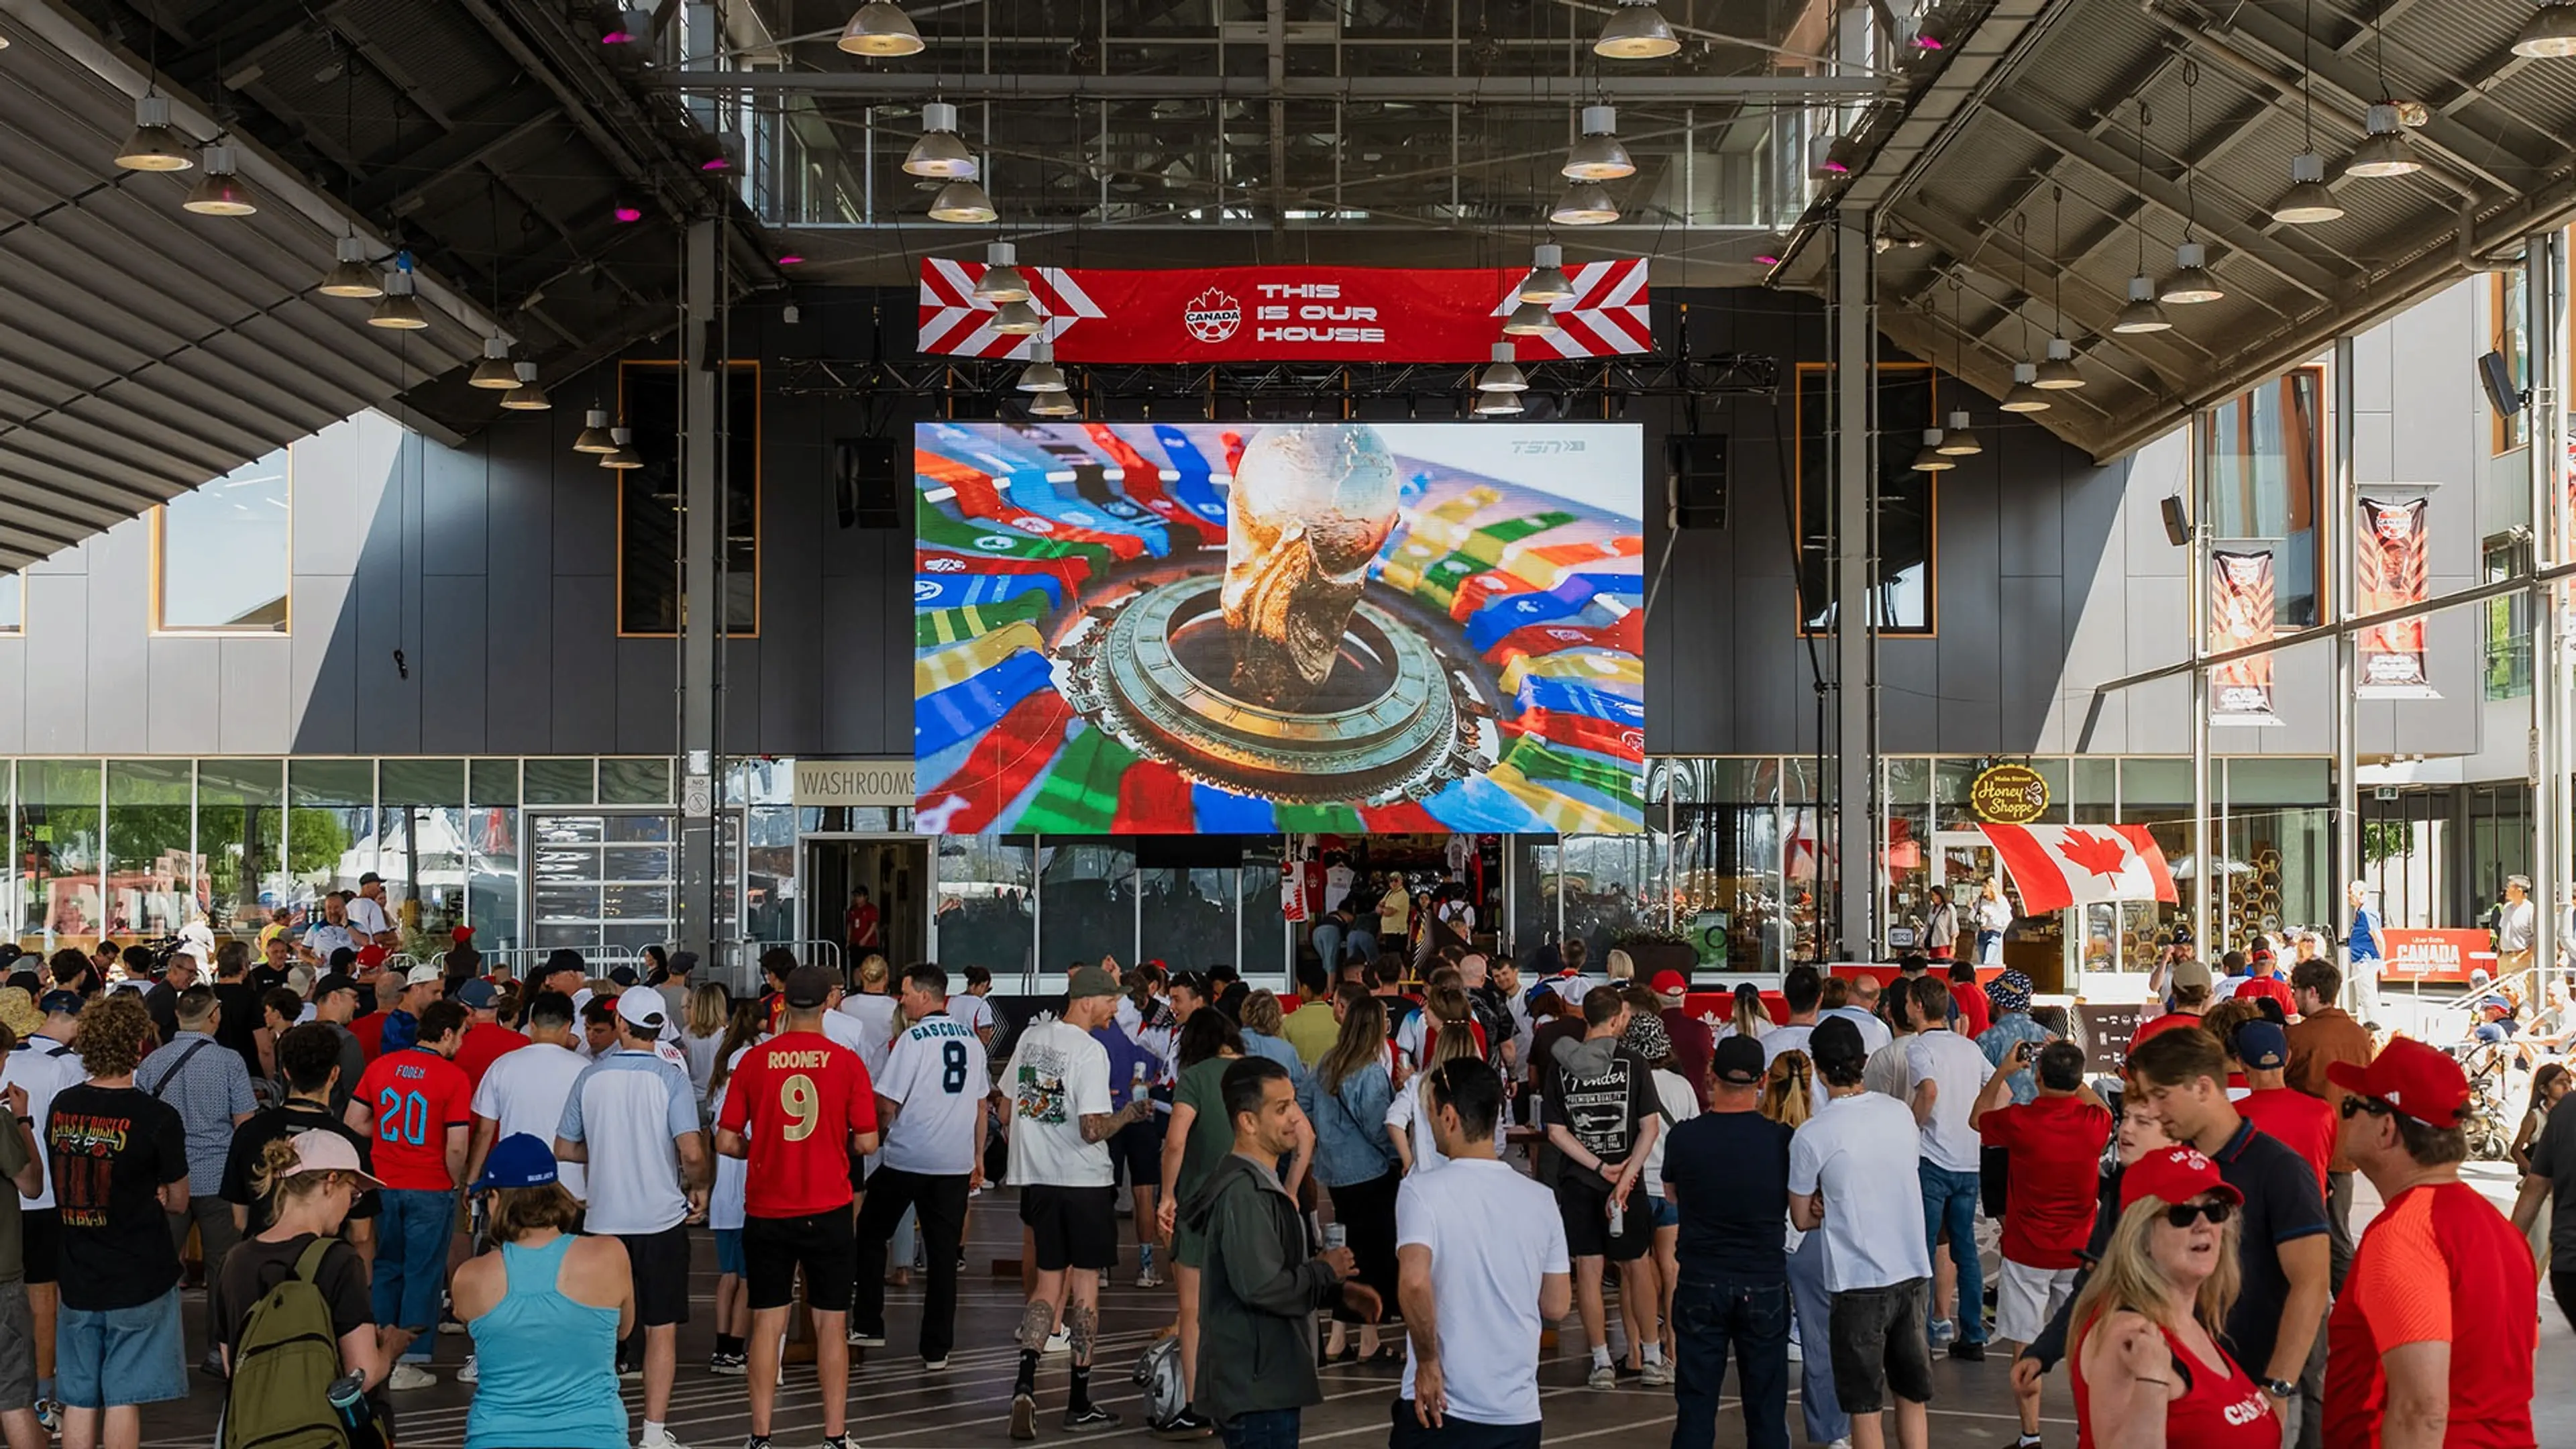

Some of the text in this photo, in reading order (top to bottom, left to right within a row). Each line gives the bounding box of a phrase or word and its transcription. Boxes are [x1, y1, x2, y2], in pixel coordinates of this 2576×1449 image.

[1257, 284, 1340, 299] THIS
[1186, 311, 1240, 321] CANADA
[1257, 306, 1377, 321] IS OUR
[1257, 327, 1385, 343] HOUSE
[801, 771, 915, 796] WASHROOMS
[1978, 780, 2024, 803] Honey
[1988, 796, 2034, 818] Shoppe
[2397, 945, 2461, 963] CANADA
[768, 1050, 831, 1069] ROONEY
[943, 1040, 967, 1093] 8
[395, 1064, 425, 1079] FODEN
[380, 1087, 428, 1145] 20
[780, 1074, 819, 1140] 9
